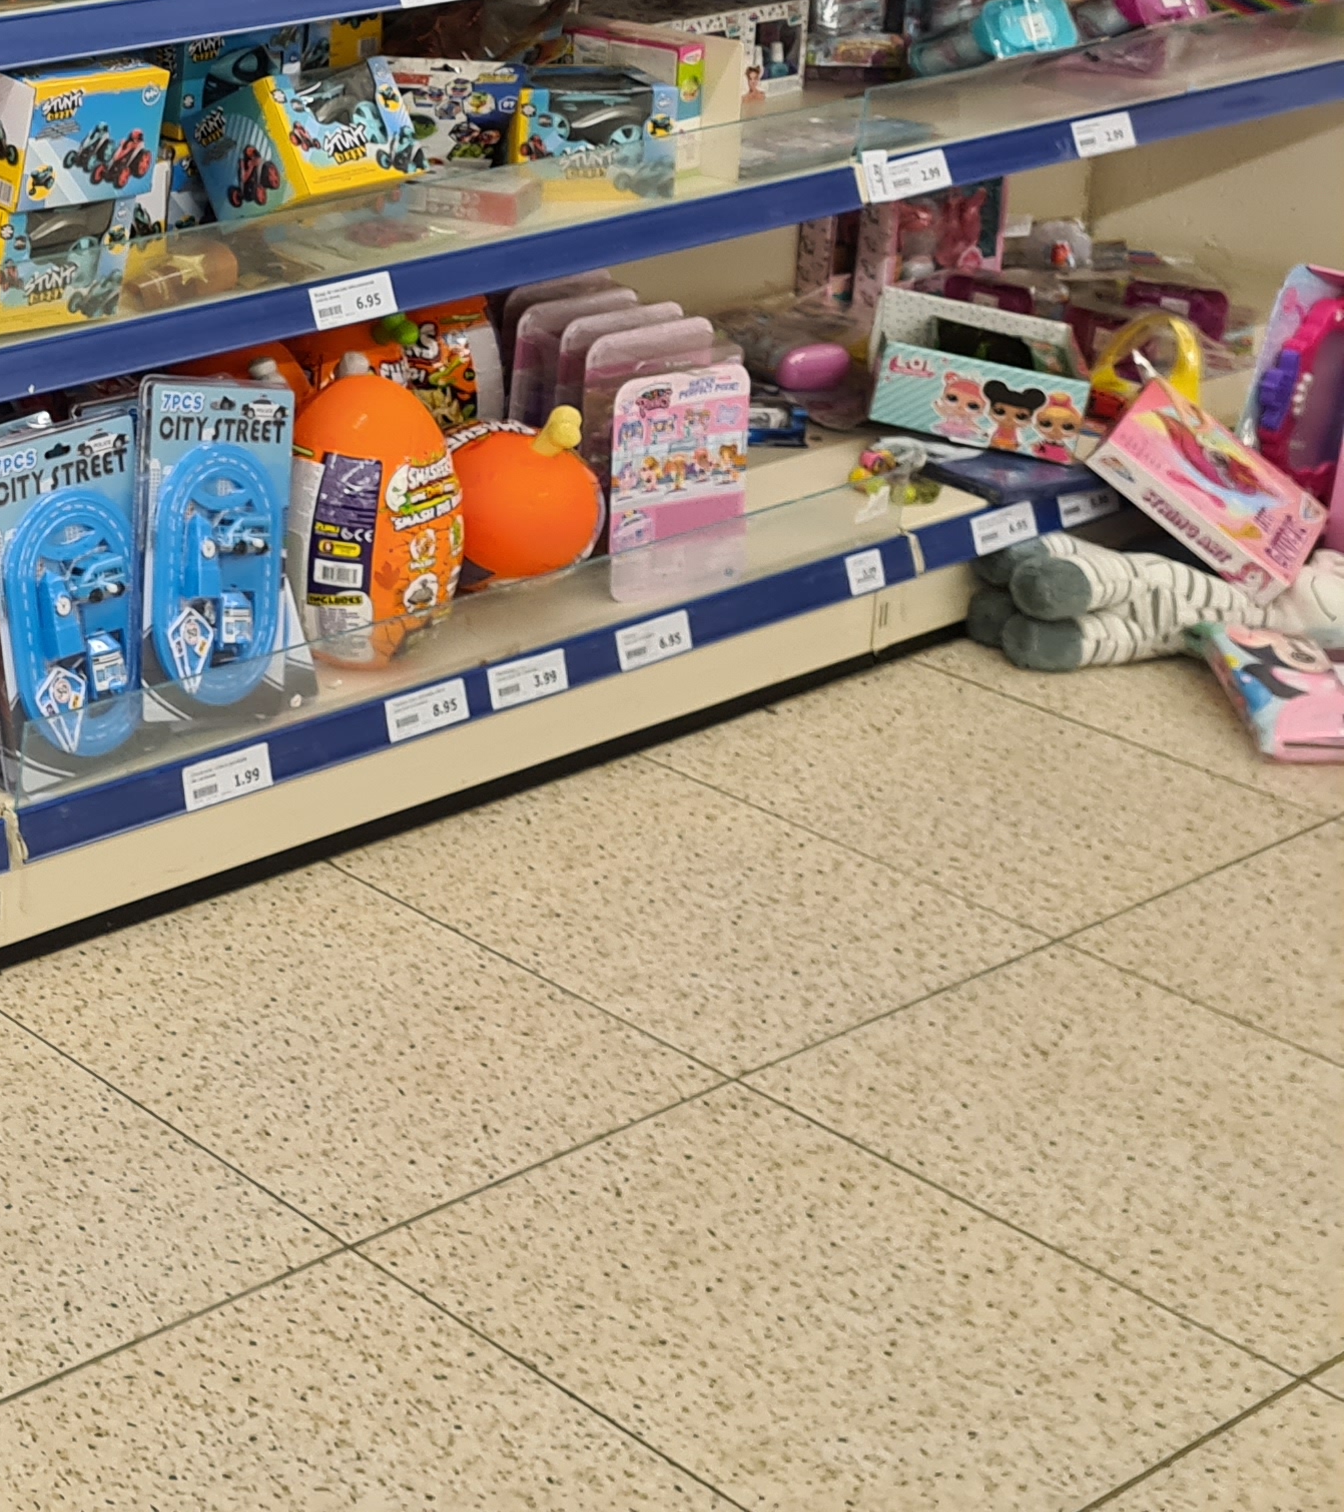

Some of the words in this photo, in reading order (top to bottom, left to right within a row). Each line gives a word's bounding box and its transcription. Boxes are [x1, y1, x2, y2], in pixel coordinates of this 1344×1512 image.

[42, 89, 86, 113] STUNT
[323, 121, 368, 157] STUNT
[356, 293, 381, 310] 6.95
[161, 392, 204, 414] 7PCS
[159, 416, 207, 442] CITY
[212, 416, 286, 443] STREET
[51, 449, 128, 489] STREET
[534, 670, 558, 688] 3.99
[433, 698, 458, 717] 8.95
[234, 768, 261, 787] 1.99
